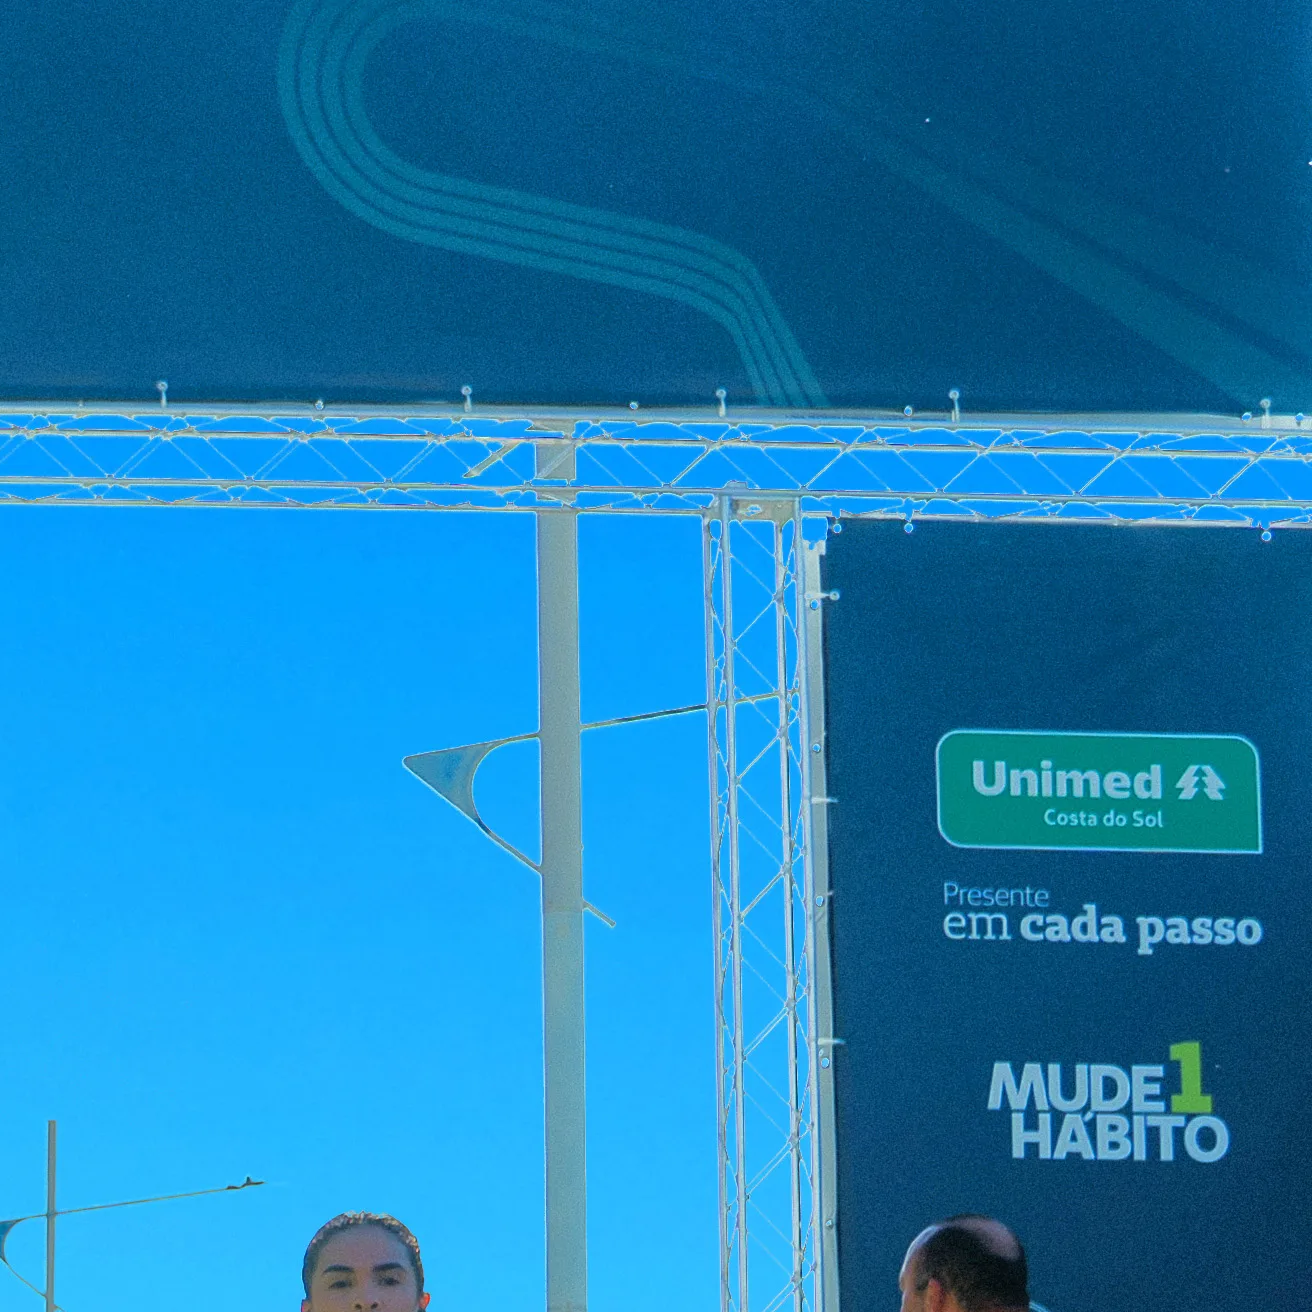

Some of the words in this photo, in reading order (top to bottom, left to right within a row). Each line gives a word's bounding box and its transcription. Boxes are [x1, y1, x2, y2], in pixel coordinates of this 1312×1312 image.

[972, 760, 1163, 799] Unimed
[1044, 810, 1097, 827] Costa
[1103, 809, 1127, 828] do
[1133, 810, 1164, 828] Sol
[943, 881, 1050, 908] Presente
[943, 911, 1012, 940] em
[1020, 904, 1126, 943] cada
[1136, 915, 1263, 955] passo
[987, 1062, 1165, 1113] MUDE
[1170, 1041, 1213, 1113] 1
[1011, 1109, 1230, 1163] HÁBITO
